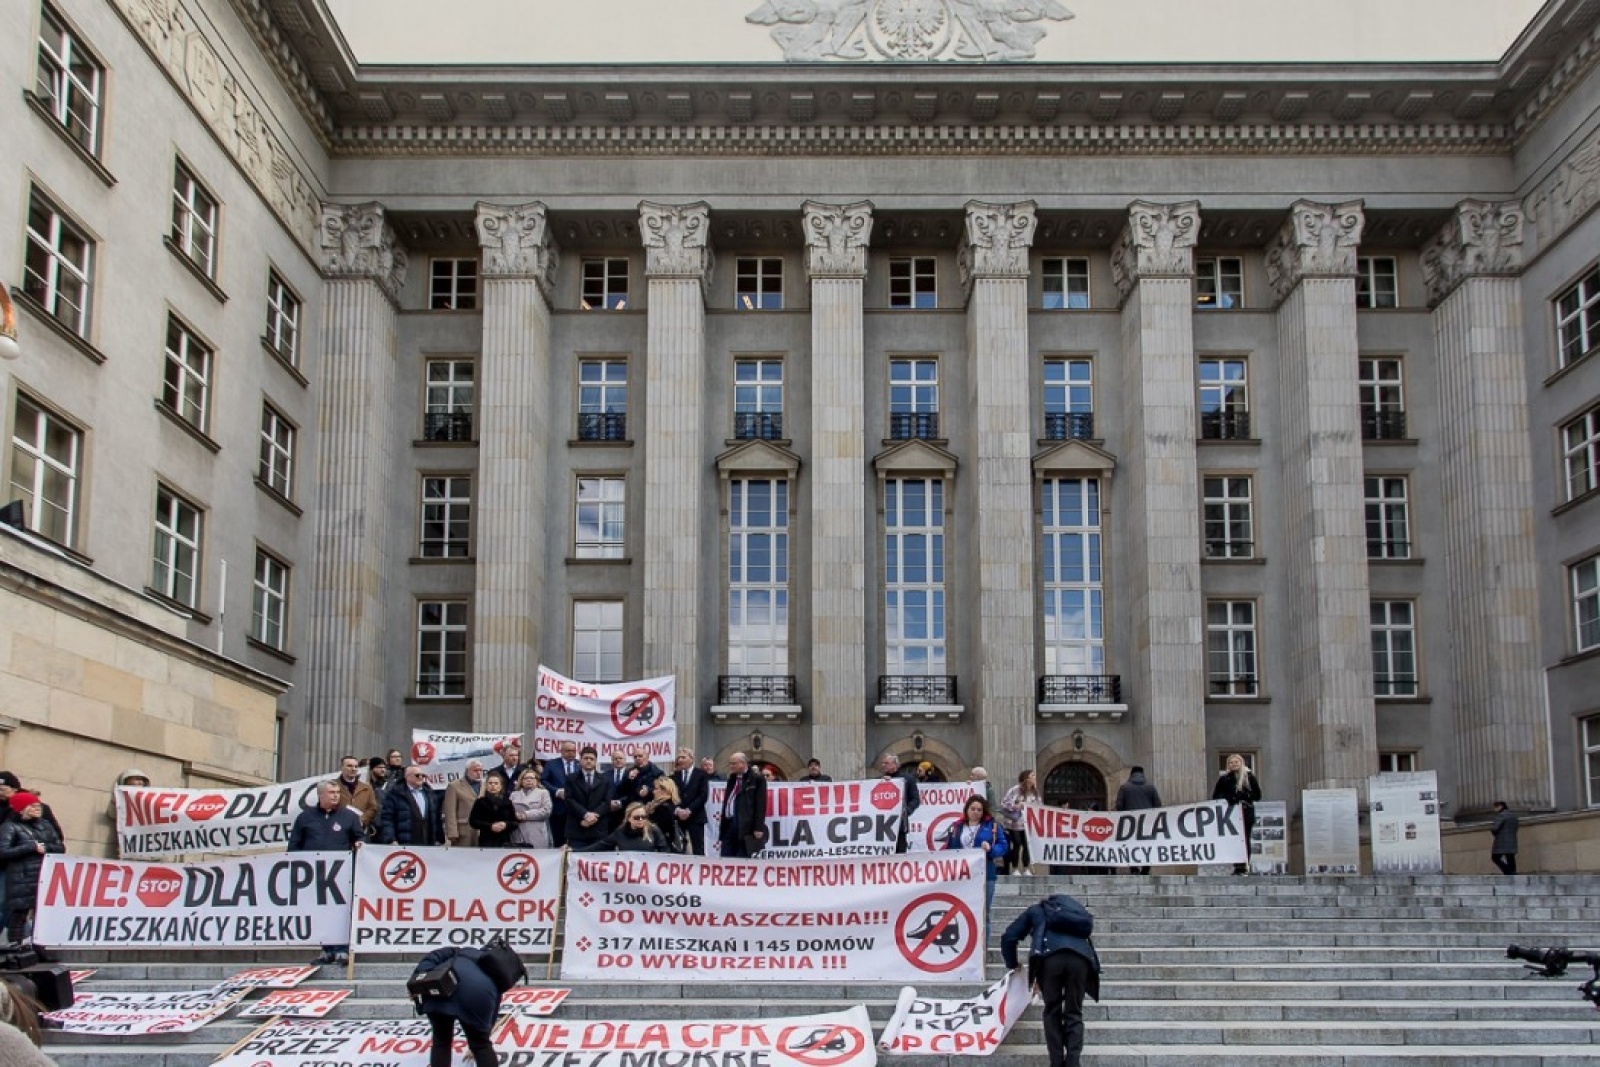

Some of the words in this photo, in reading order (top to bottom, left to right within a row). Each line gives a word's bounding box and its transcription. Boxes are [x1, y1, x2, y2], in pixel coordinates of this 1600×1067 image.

[541, 672, 564, 695] NIE
[569, 685, 599, 698] DLA
[537, 695, 567, 713] CPK
[535, 716, 584, 734] PRZEZ
[122, 790, 189, 827] NIE!
[187, 801, 225, 813] STOP
[224, 788, 292, 820] DLA
[872, 792, 897, 801] STOP
[826, 815, 899, 844] CPK
[1026, 807, 1080, 839] NIE!
[1083, 825, 1113, 834] STOP
[1115, 812, 1171, 842] DLA
[1177, 805, 1239, 838] CPK
[124, 824, 230, 854] MIESZKAŃCY
[238, 823, 292, 846] SZCZE
[1043, 843, 1151, 864] MIESZKAŃCY
[1157, 843, 1216, 862] BEŁKU
[44, 861, 133, 907] NIE!
[139, 879, 181, 893] STOP
[183, 862, 257, 907] DLA
[267, 860, 347, 905] CPK
[577, 859, 610, 883] NIE
[613, 861, 650, 884] DLA
[656, 863, 694, 885] CPK
[699, 864, 758, 887] PRZEZ
[763, 863, 855, 887] CENTRUM
[862, 858, 971, 885] MIKOŁOWA
[357, 897, 414, 922] NIE
[423, 898, 489, 922] DLA
[495, 898, 556, 923] CPK
[601, 892, 647, 905] 1500
[651, 892, 702, 908] OSÓB
[68, 911, 231, 942] MIESZKAŃCY
[234, 914, 312, 941] BEŁKU
[599, 909, 635, 924] DO
[641, 910, 889, 927] WYWŁASZCZENIA!!!
[356, 927, 443, 946] PRZEZ
[448, 927, 553, 946] ORZESZ
[597, 937, 634, 950] 317
[639, 937, 737, 953] MIESZKAŃ
[743, 940, 749, 952] I
[755, 940, 790, 952] 145
[796, 936, 875, 952] DOMÓW
[597, 954, 633, 969] DO
[641, 954, 813, 969] WYBURZENIA
[502, 988, 570, 1011] TOP!
[494, 1018, 570, 1048] NIE
[580, 1022, 670, 1049] DLA
[681, 1023, 771, 1048] CPK
[930, 1027, 999, 1053] CPK
[233, 1038, 350, 1056] PRZEZ
[620, 1050, 771, 1067] MOKRE
